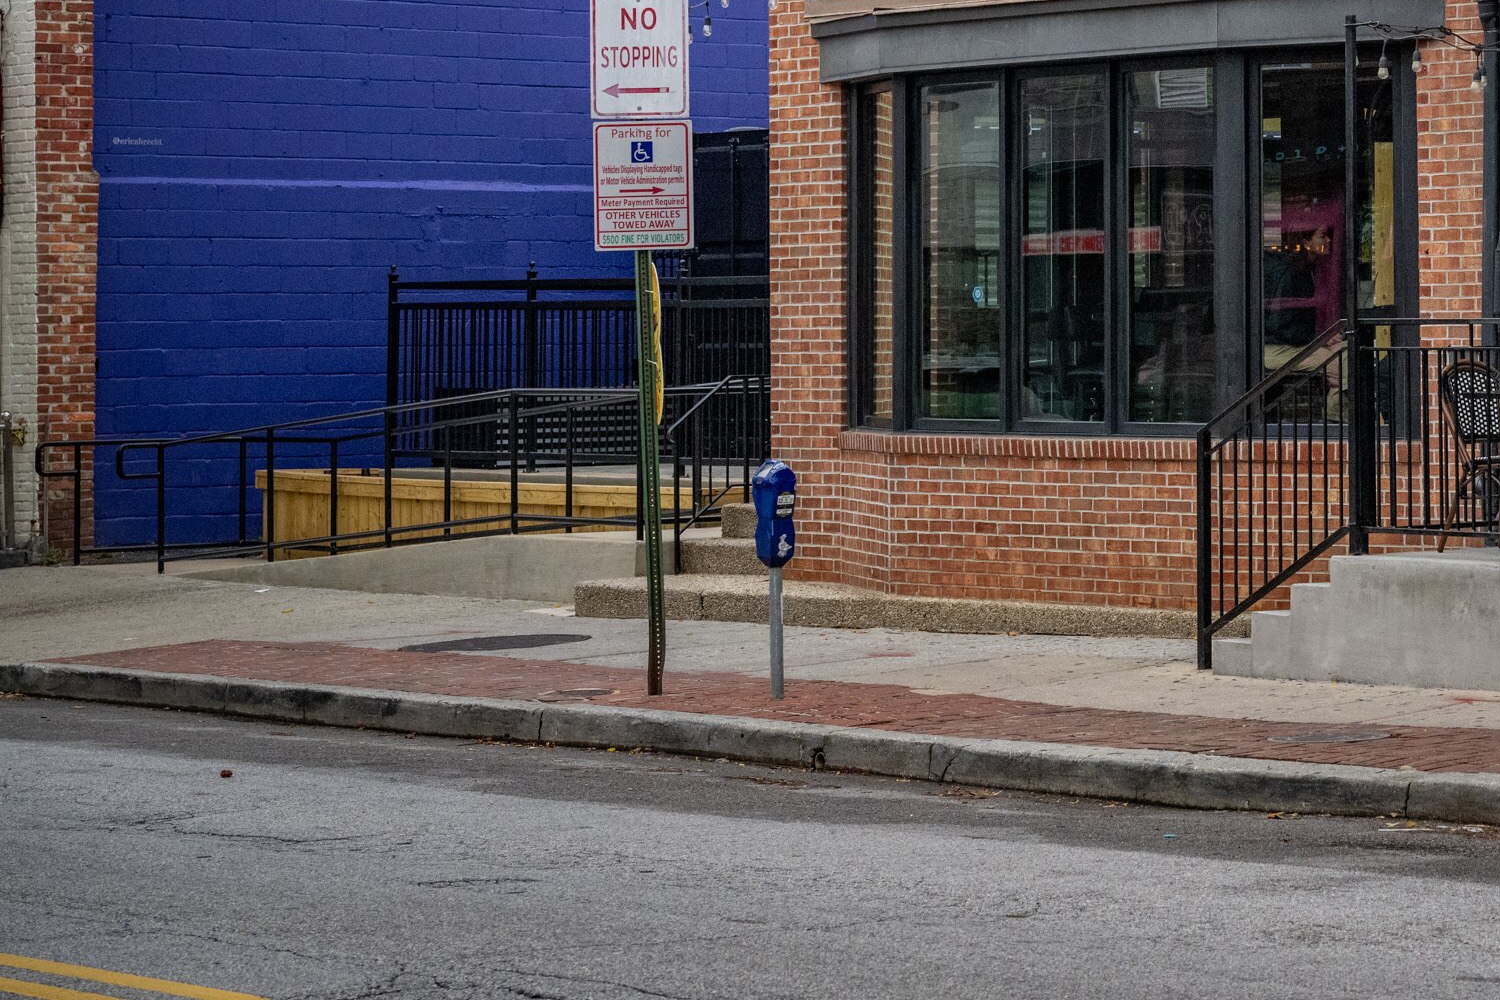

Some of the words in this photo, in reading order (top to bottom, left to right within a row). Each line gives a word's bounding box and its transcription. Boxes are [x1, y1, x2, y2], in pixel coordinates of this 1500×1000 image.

[620, 7, 657, 30] NO
[601, 45, 678, 68] STOPPING
[611, 128, 652, 140] Parking
[655, 127, 671, 138] for
[602, 165, 620, 174] Vehicles
[644, 164, 673, 174] Handicapped
[673, 165, 683, 174] tags
[601, 199, 622, 207] Meter
[623, 198, 654, 208] Payment
[655, 197, 685, 206] Required
[605, 211, 636, 220] OTHER
[638, 210, 681, 219] VEHICLES
[612, 221, 647, 229] TOWED
[648, 220, 676, 229] AWAY
[602, 234, 619, 245] $500
[621, 234, 635, 244] FINE
[636, 234, 649, 244] FOR
[650, 233, 685, 243] VIOLATORS
